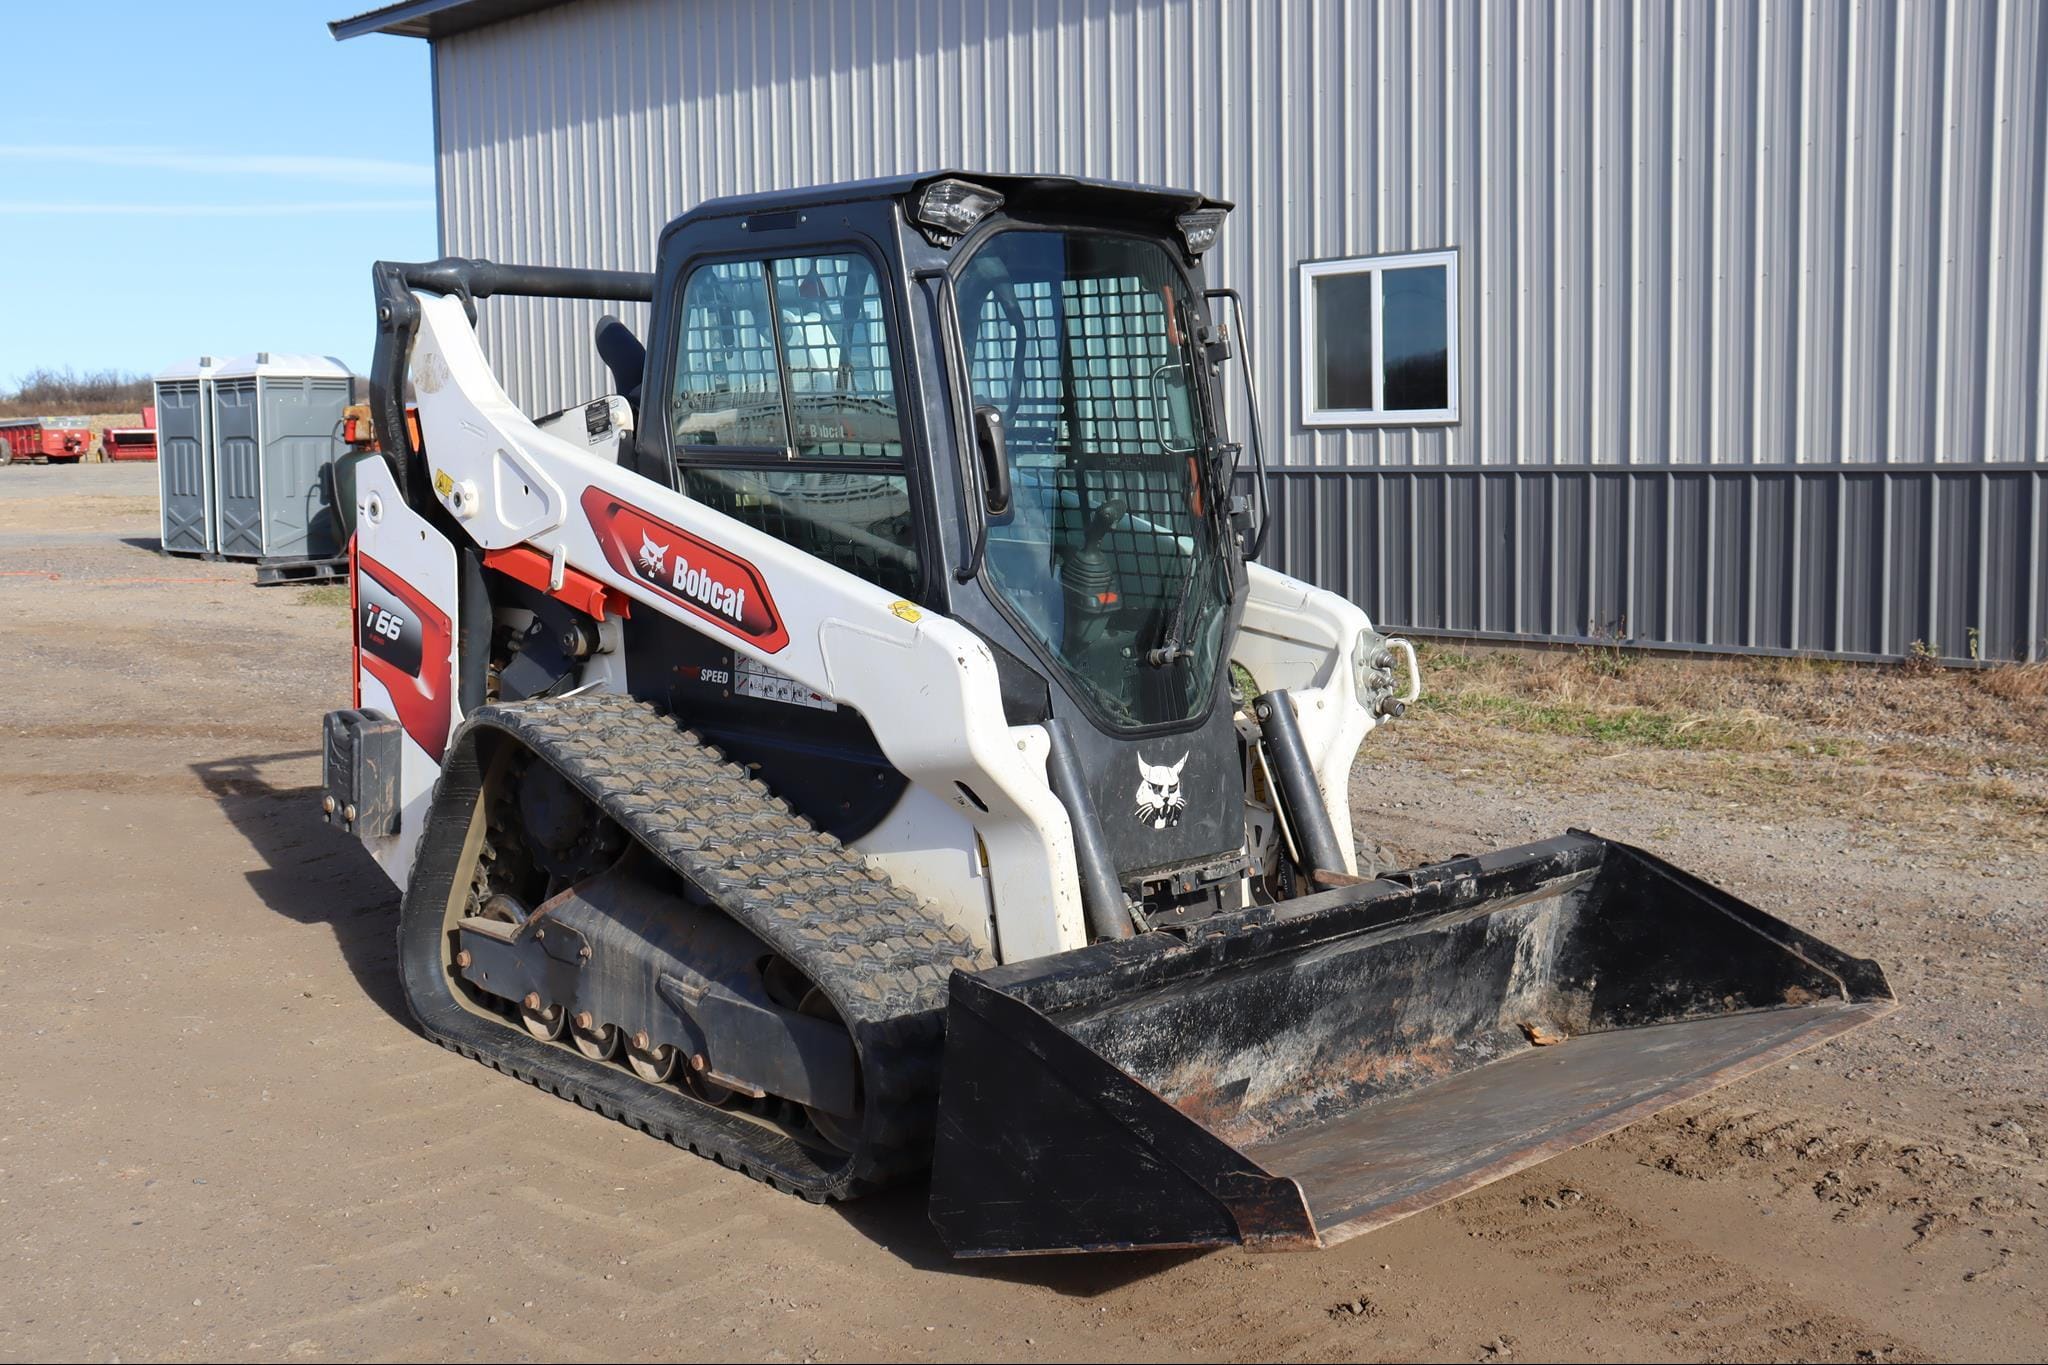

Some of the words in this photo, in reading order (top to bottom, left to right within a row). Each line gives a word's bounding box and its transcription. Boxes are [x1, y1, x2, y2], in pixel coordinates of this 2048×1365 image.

[672, 555, 745, 622] Bobcat
[366, 603, 404, 641] T66
[701, 668, 729, 684] SPEED
